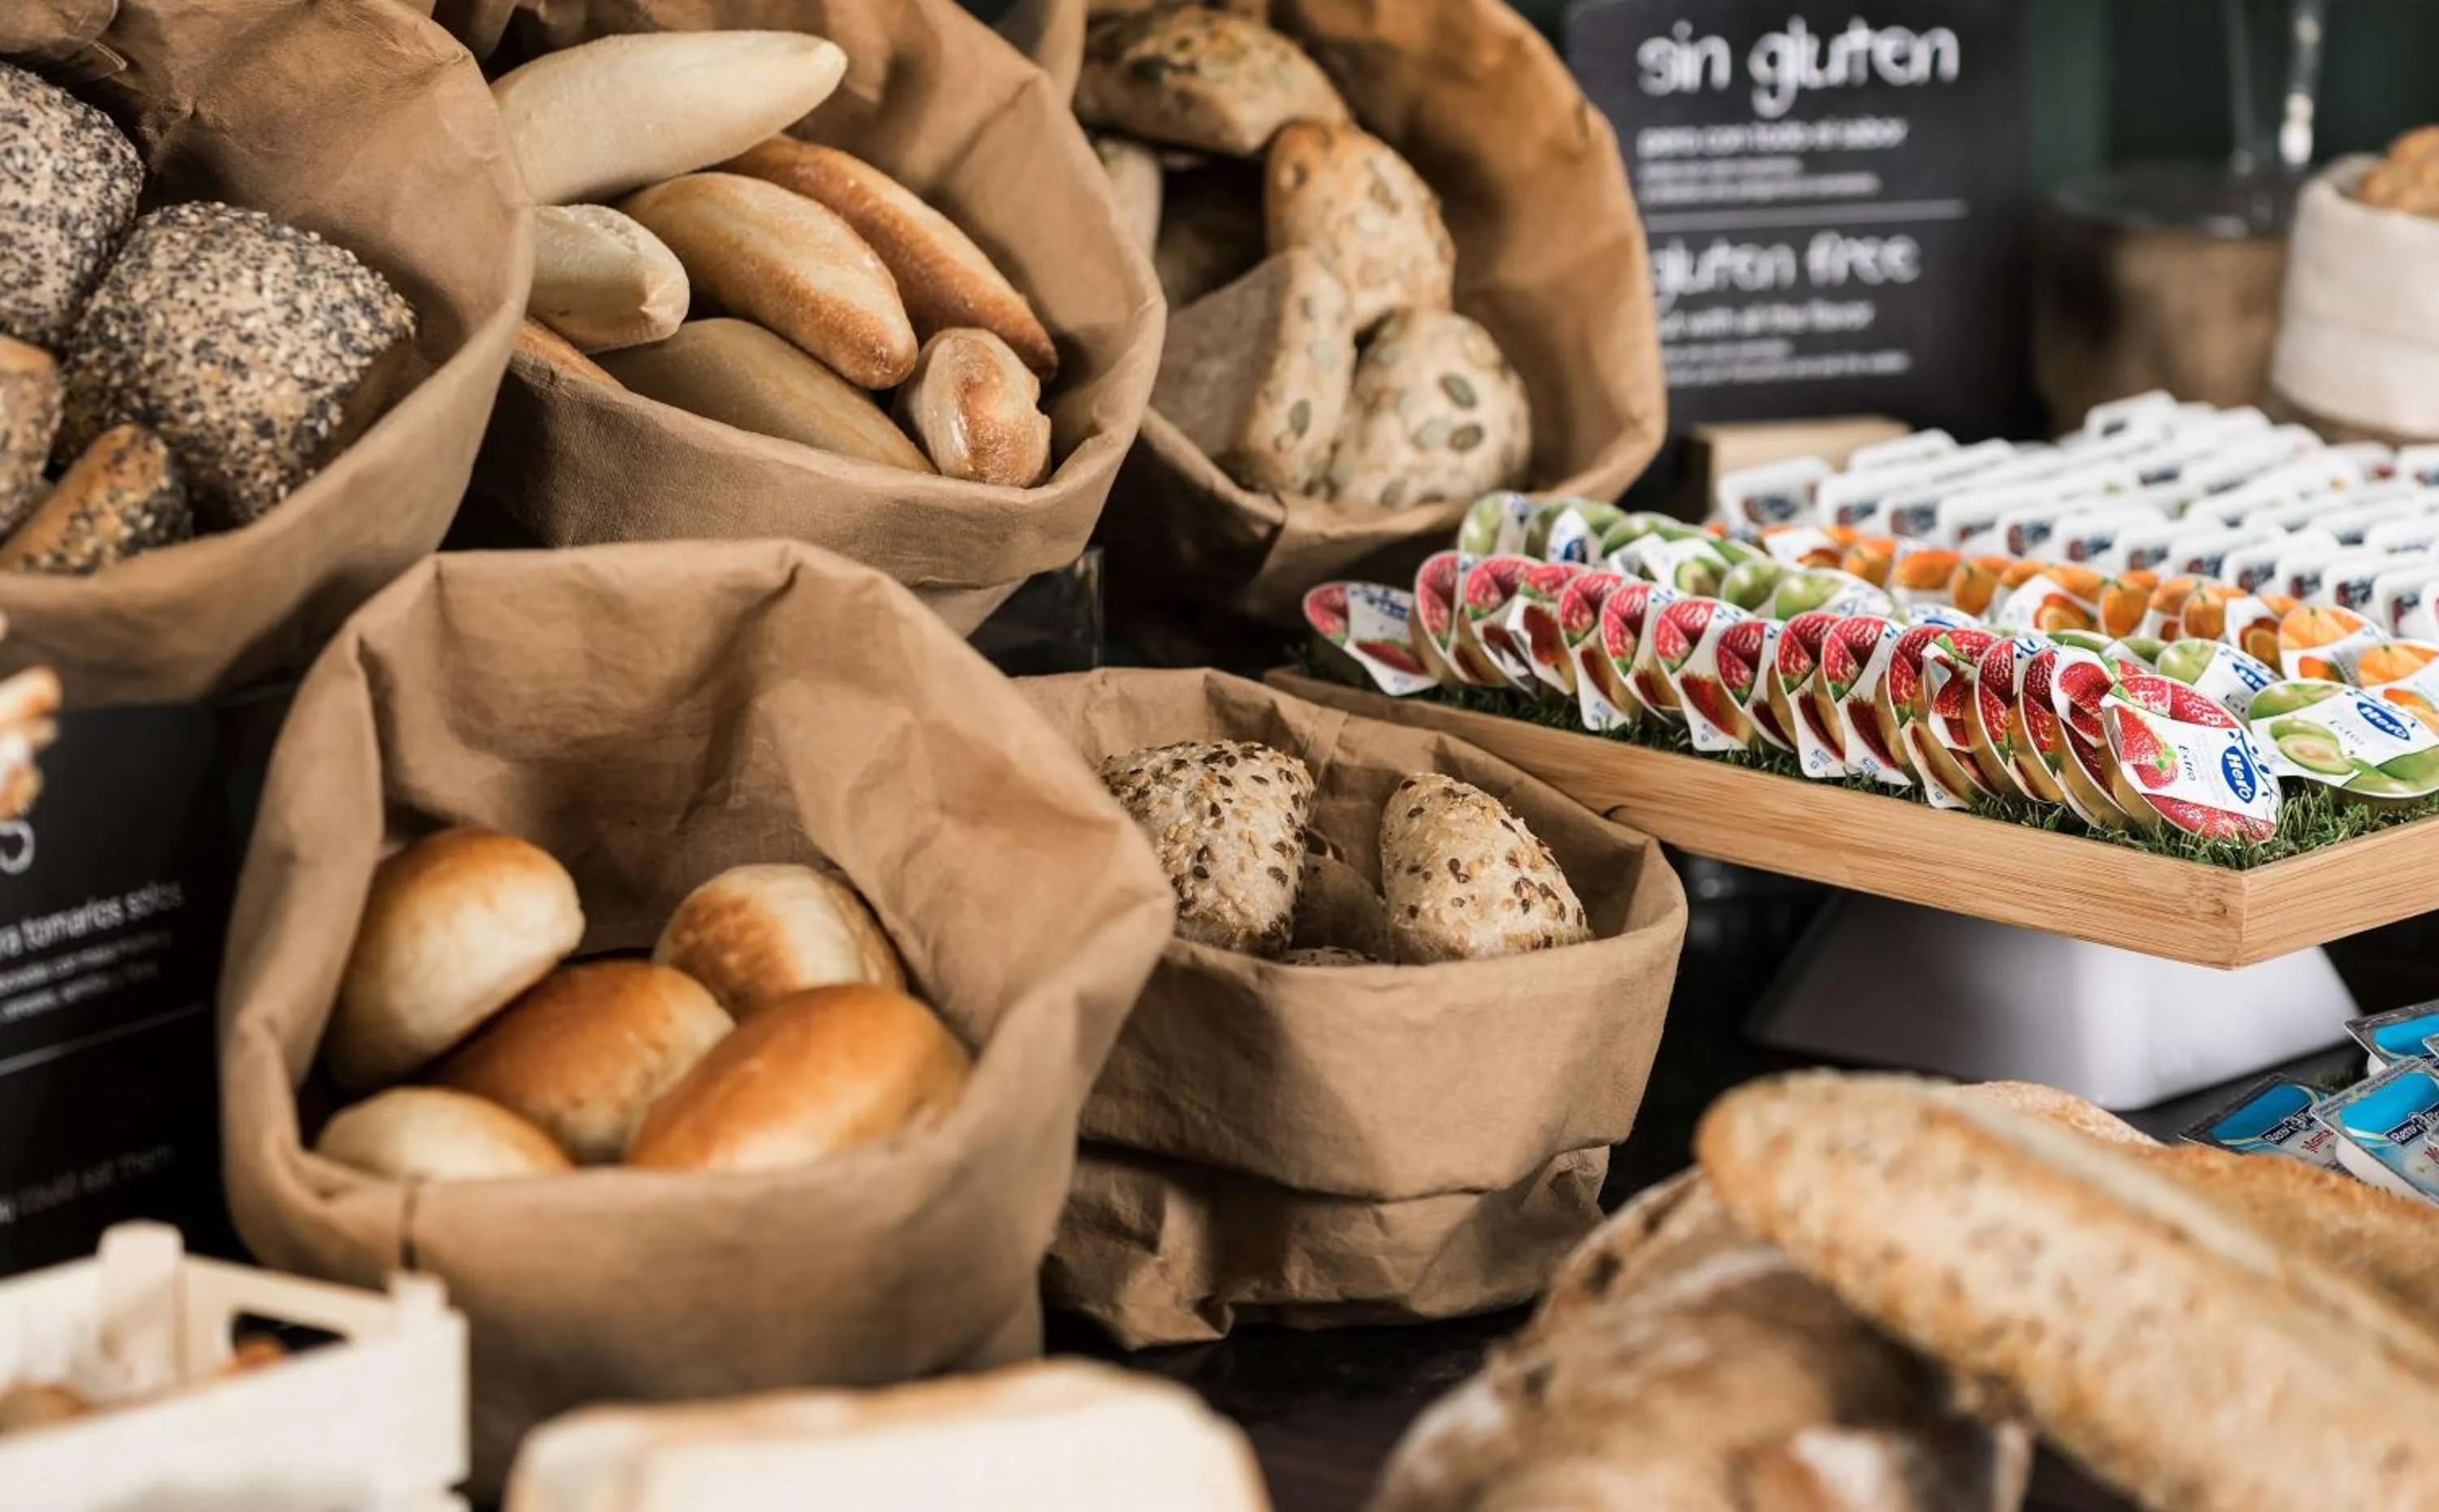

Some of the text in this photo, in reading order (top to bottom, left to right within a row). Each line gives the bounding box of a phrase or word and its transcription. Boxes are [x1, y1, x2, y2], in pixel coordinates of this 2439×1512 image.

[1637, 15, 1960, 119] sin gluten
[2225, 753, 2253, 801] Hero
